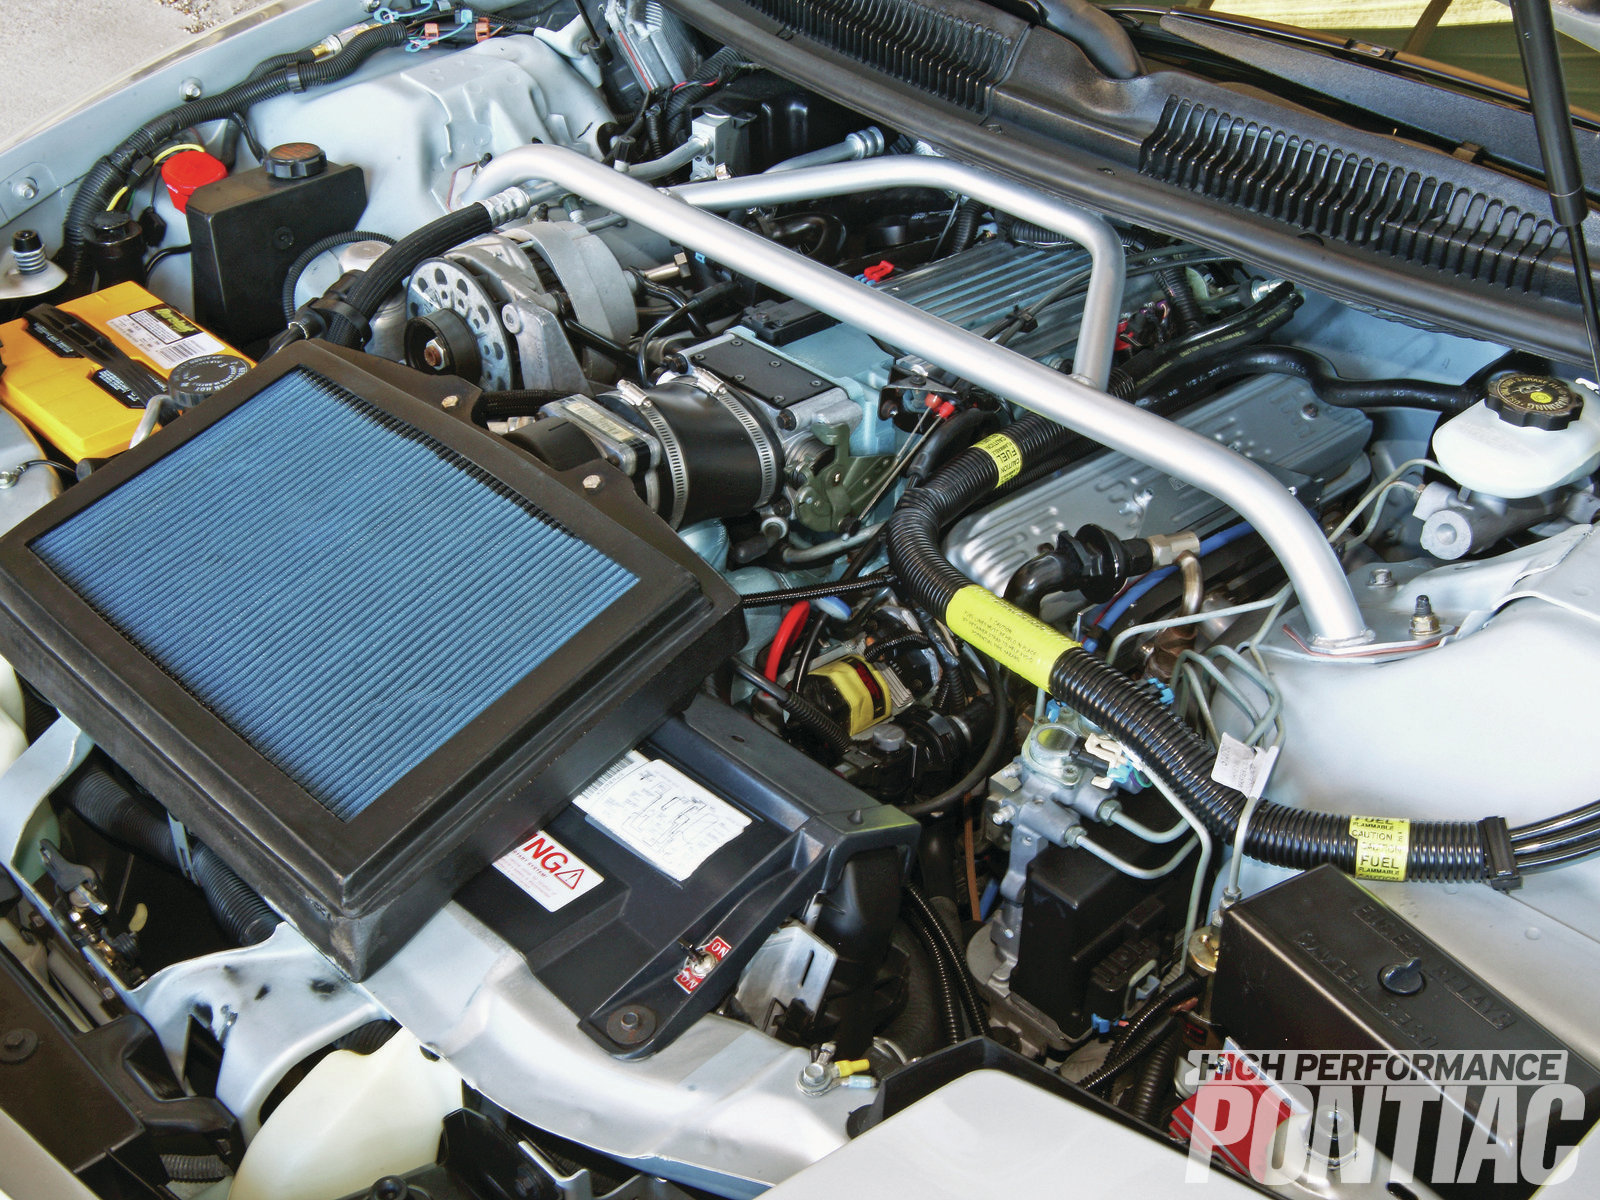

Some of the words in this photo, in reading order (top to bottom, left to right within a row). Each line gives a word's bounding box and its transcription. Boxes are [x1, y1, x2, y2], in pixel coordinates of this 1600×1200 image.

[1526, 396, 1570, 411] WARNING
[996, 447, 1017, 463] FUEL
[1352, 829, 1393, 840] CAUTION
[1360, 855, 1399, 869] FUEL
[709, 940, 729, 958] ON
